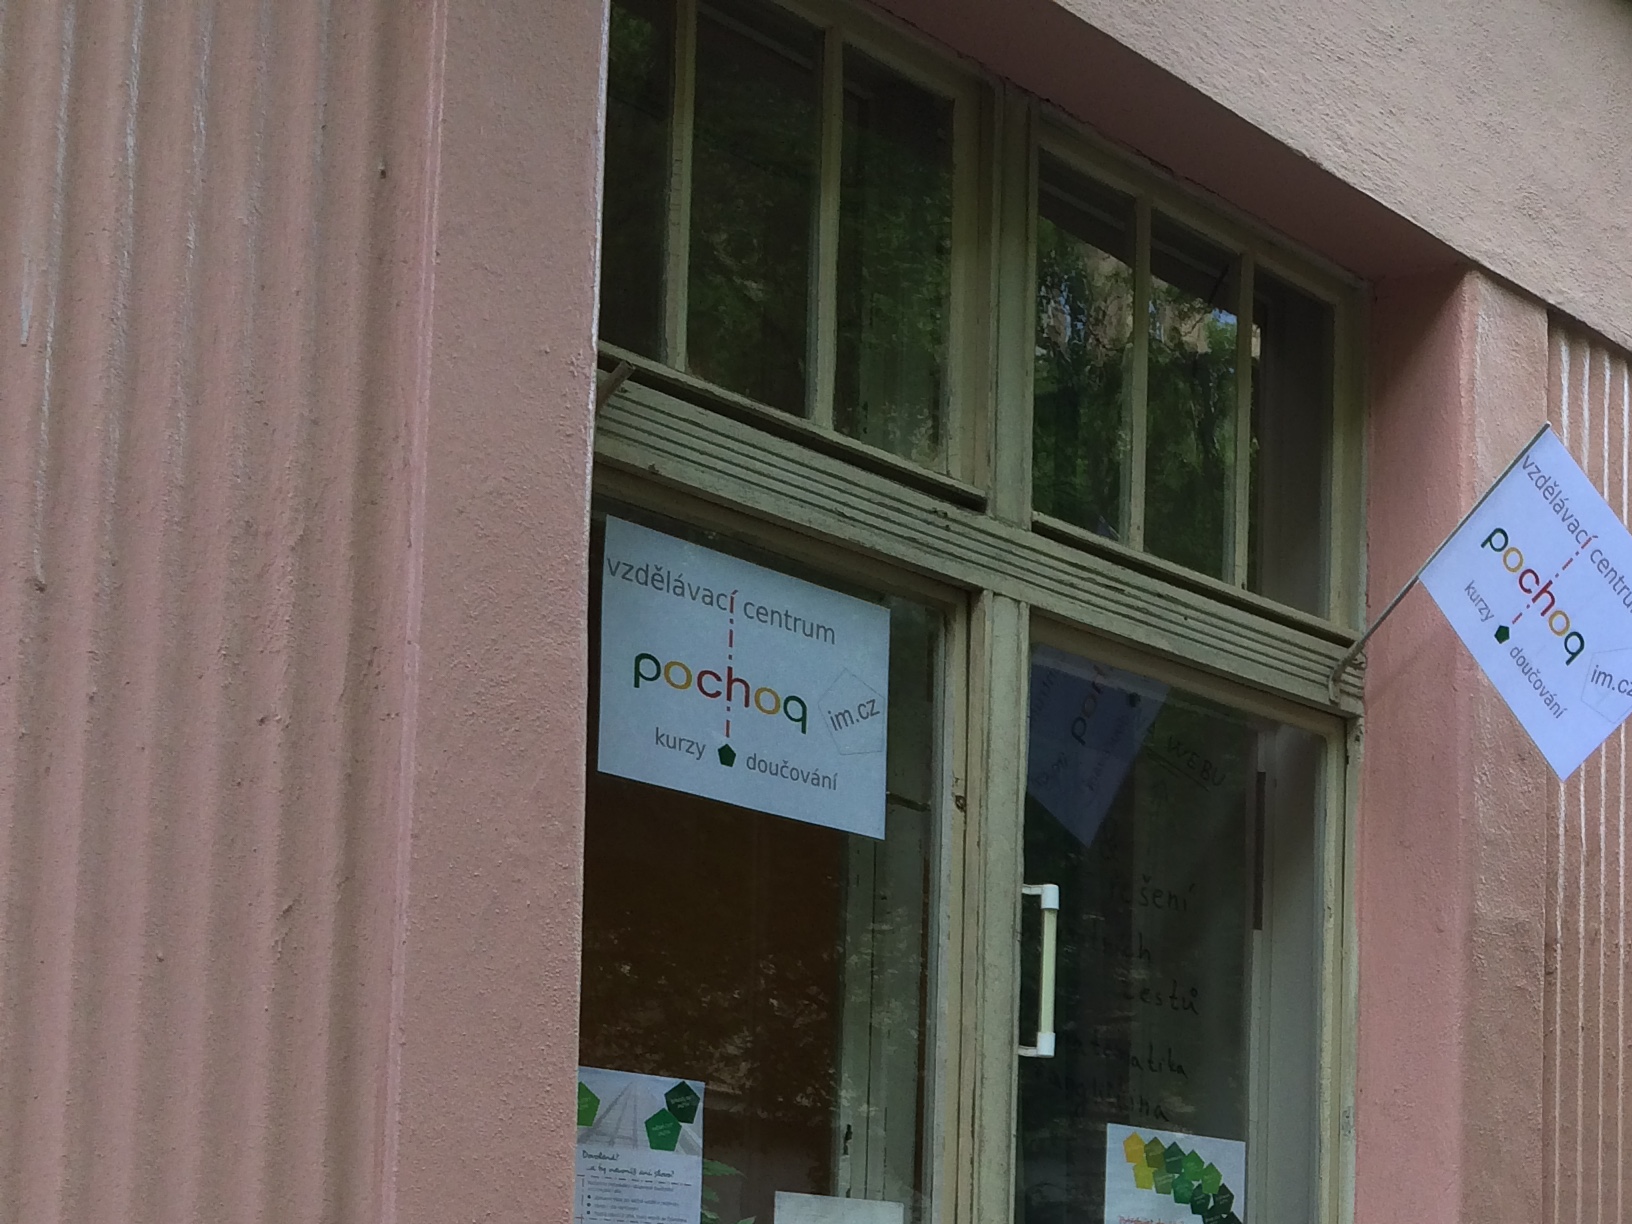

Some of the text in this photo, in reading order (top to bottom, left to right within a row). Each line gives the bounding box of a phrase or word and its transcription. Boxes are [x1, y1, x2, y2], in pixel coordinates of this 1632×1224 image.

[1522, 455, 1598, 549] vzdělávací
[607, 557, 836, 645] vzdělávací centrum
[1464, 580, 1568, 719] kurzy doučování
[655, 727, 838, 790] kurzy doučování
[828, 698, 880, 731] im.cz
